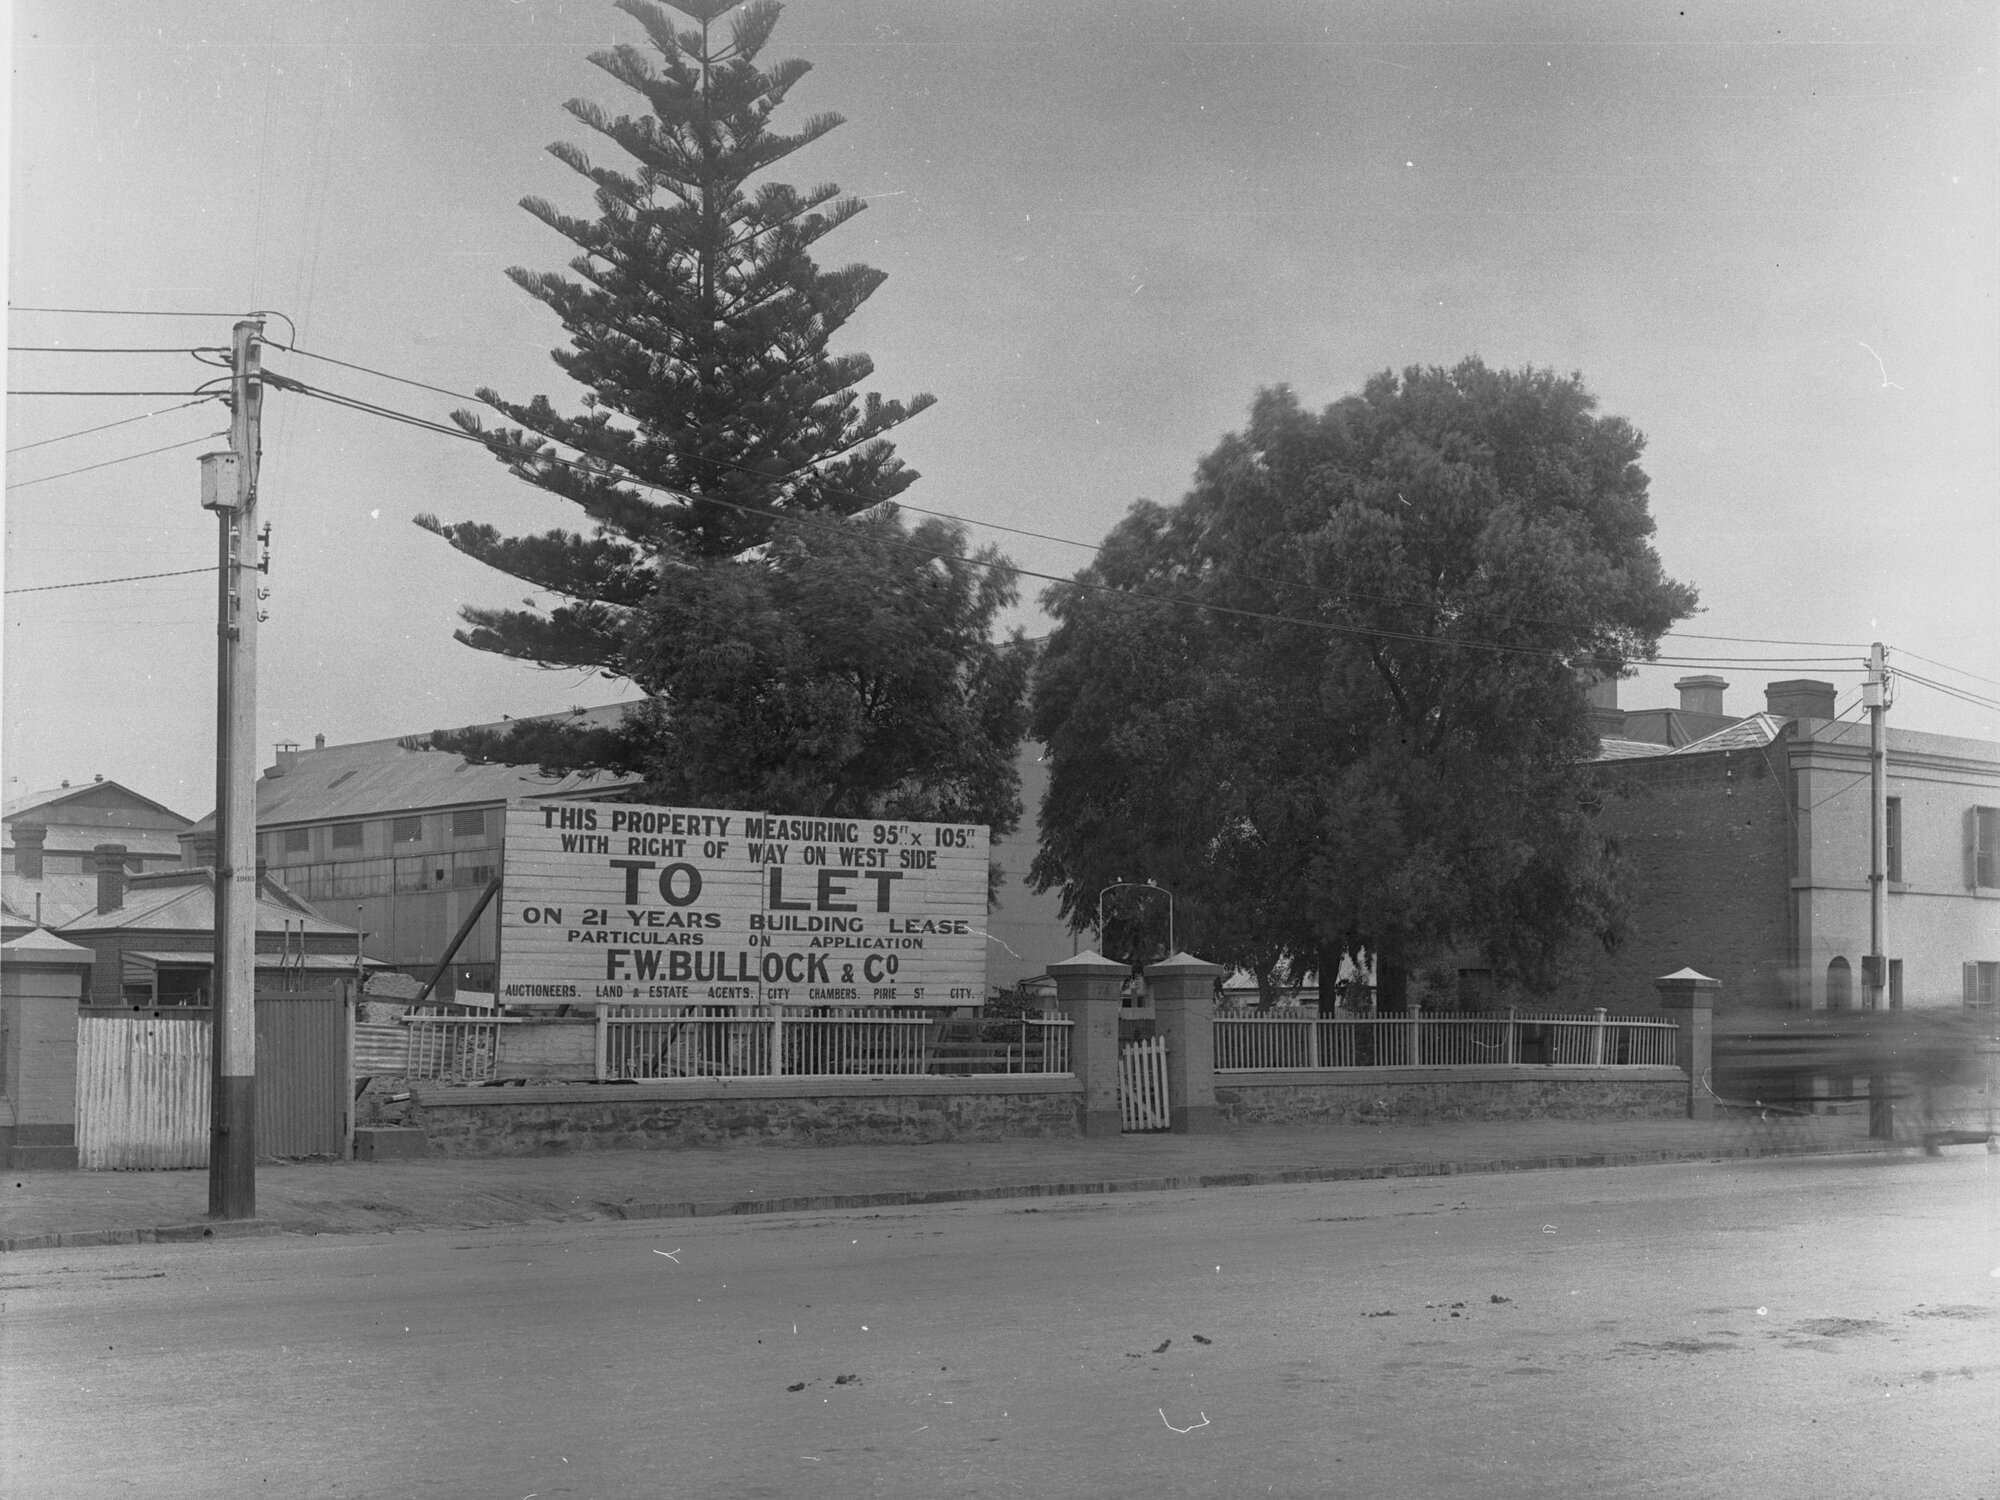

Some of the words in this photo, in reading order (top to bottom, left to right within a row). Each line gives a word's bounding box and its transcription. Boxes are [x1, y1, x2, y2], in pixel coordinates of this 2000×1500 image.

[539, 806, 597, 831] THIS
[612, 810, 731, 837] PROPERTY
[745, 817, 859, 843] MEASURING
[561, 834, 609, 854] WITH
[628, 837, 686, 857] RIGHT
[703, 840, 729, 858] OF
[748, 842, 789, 864] WAY
[804, 846, 826, 866] ON
[839, 847, 888, 867] WEST
[900, 849, 937, 869] SIDE
[609, 859, 703, 907] TO
[769, 866, 904, 913] LET
[522, 907, 562, 924] ON
[581, 909, 608, 926] 21
[626, 910, 722, 929] YEARS
[750, 914, 864, 933] BUILDING
[889, 918, 969, 935] LEASE
[568, 930, 704, 945] PARTICULARS
[748, 934, 771, 947] ON
[809, 936, 923, 949] APPLICATION
[841, 963, 854, 984] &
[596, 985, 623, 998] LAND
[632, 987, 640, 998] &
[649, 986, 689, 998] ESTATE
[767, 988, 791, 1000] CITY
[873, 988, 897, 999] PIRIE
